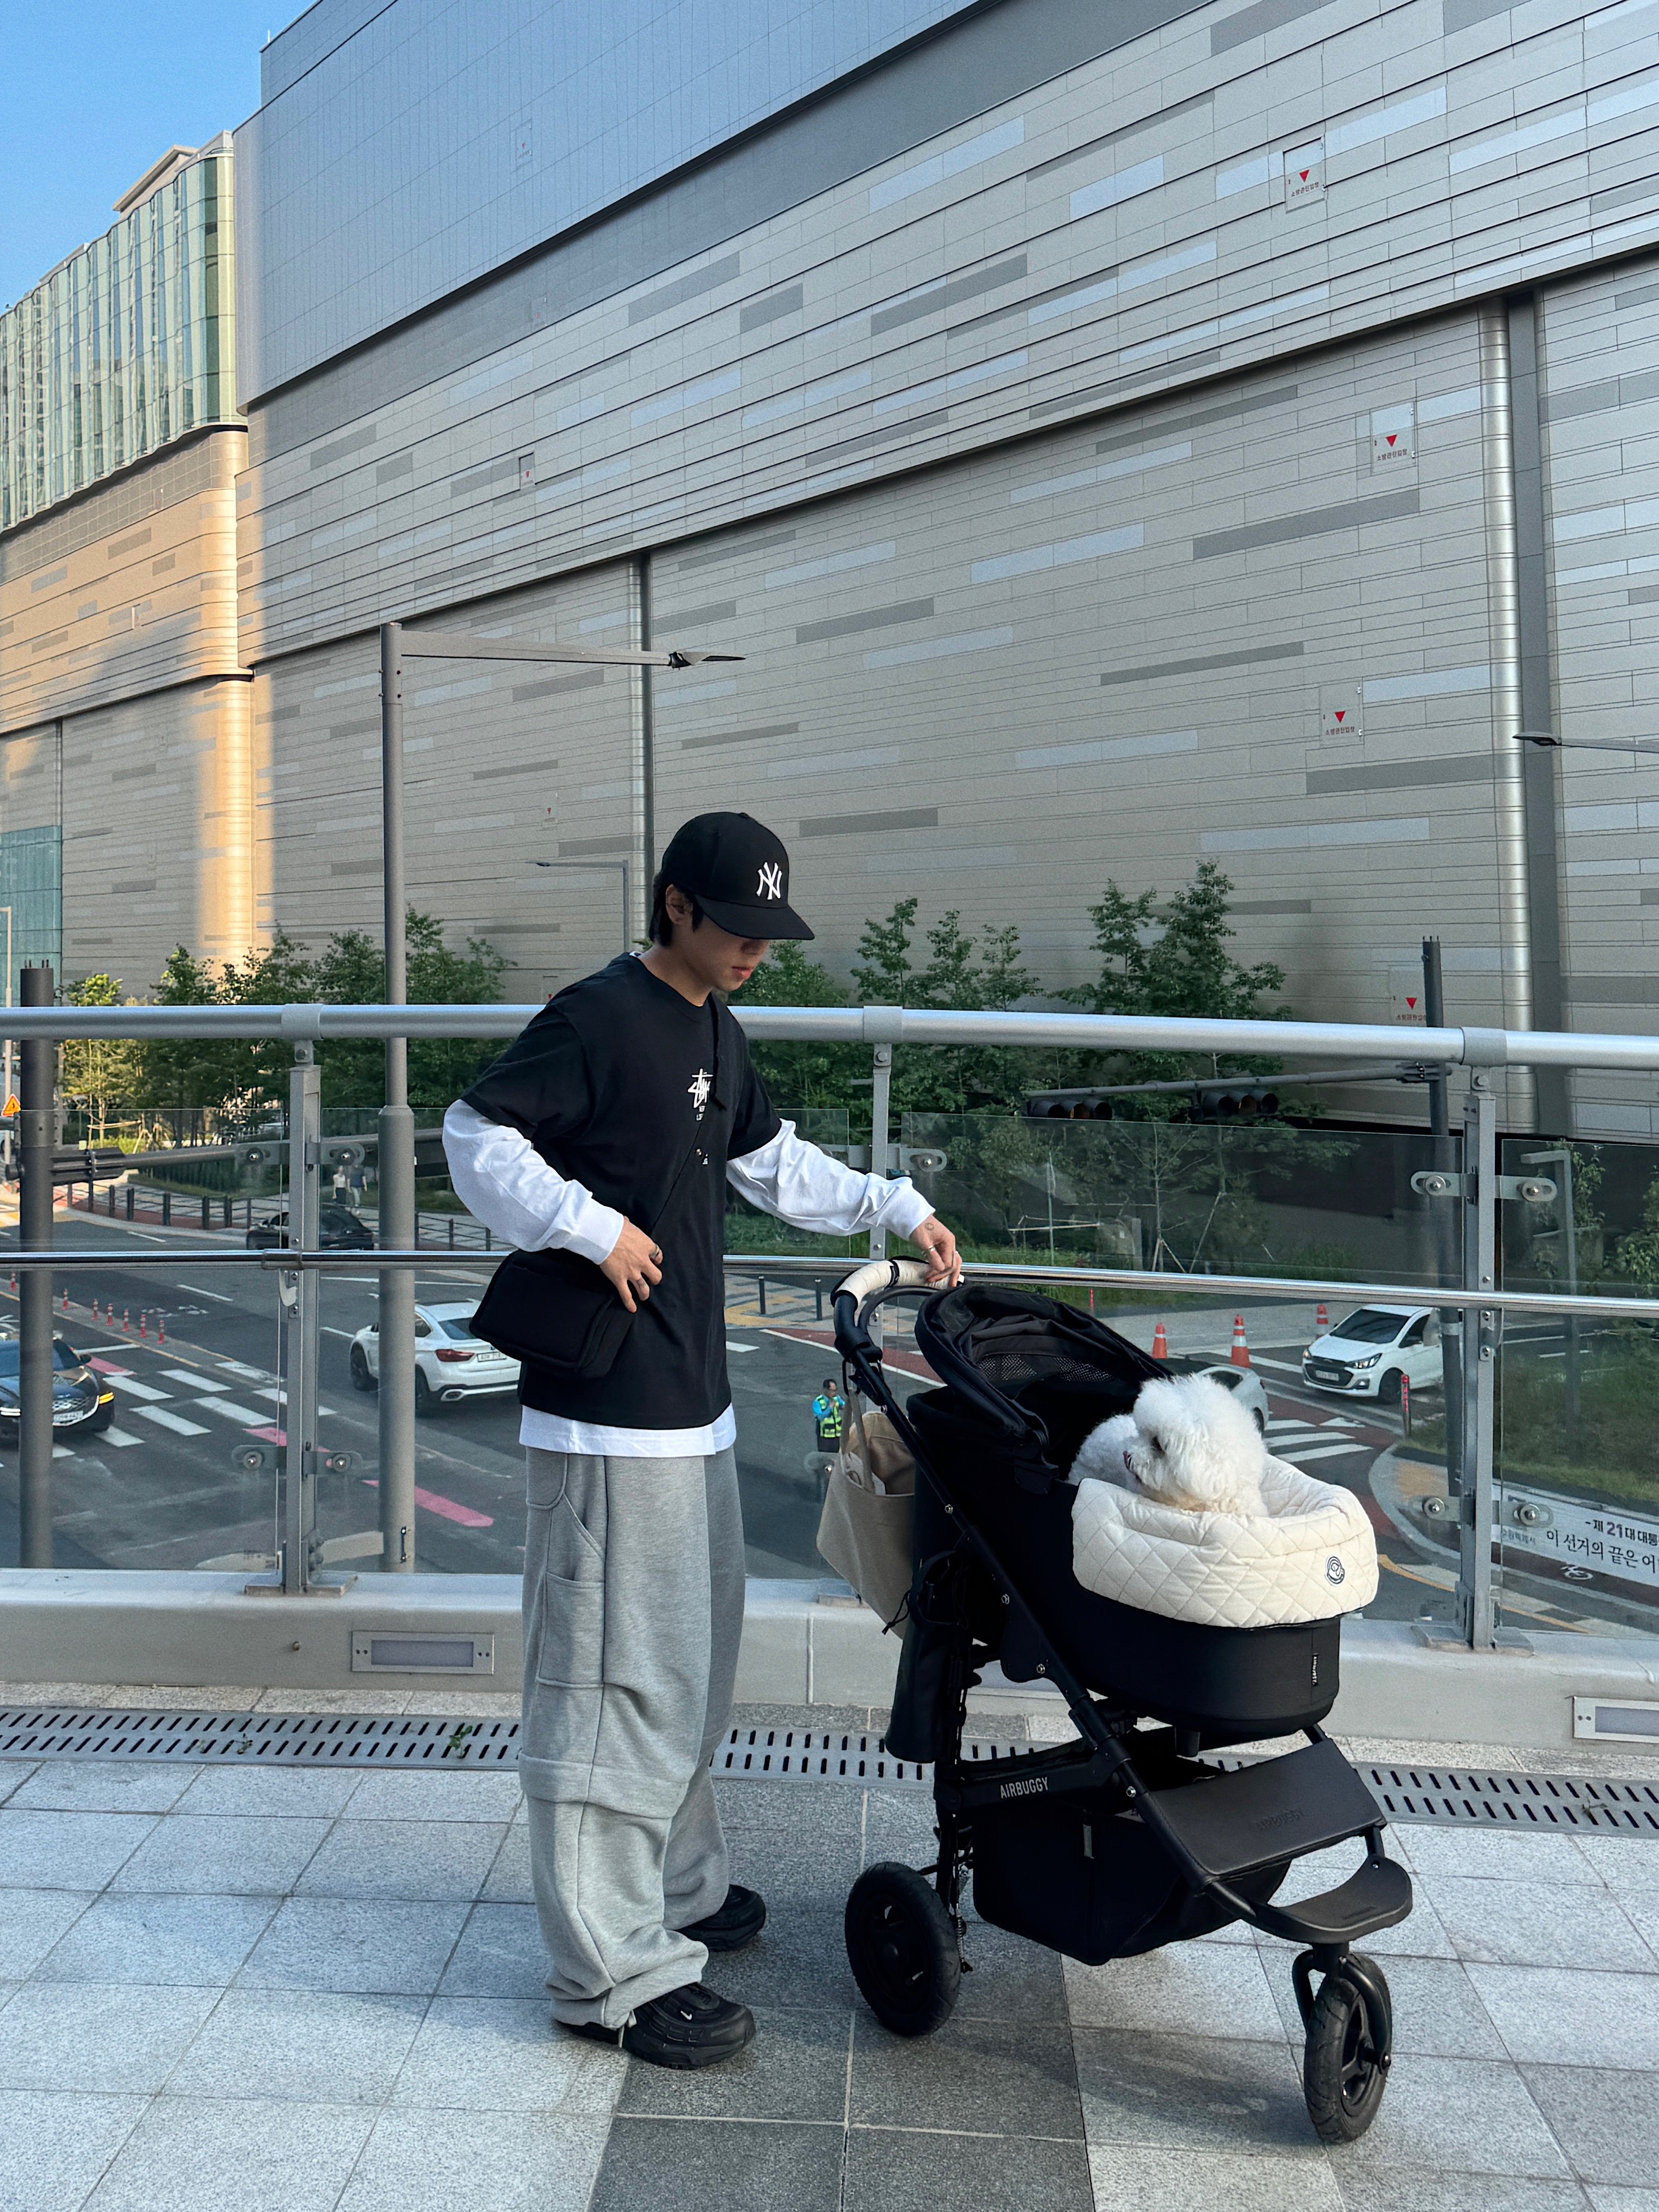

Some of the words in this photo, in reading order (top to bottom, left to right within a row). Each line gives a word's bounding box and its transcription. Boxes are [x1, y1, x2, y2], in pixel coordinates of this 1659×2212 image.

[756, 862, 782, 900] NY
[1547, 1529, 1559, 1547] 이
[1563, 1534, 1603, 1561] 선거의
[1608, 1545, 1638, 1569] 끝은
[1000, 1777, 1048, 1799] AIRBUGGY
